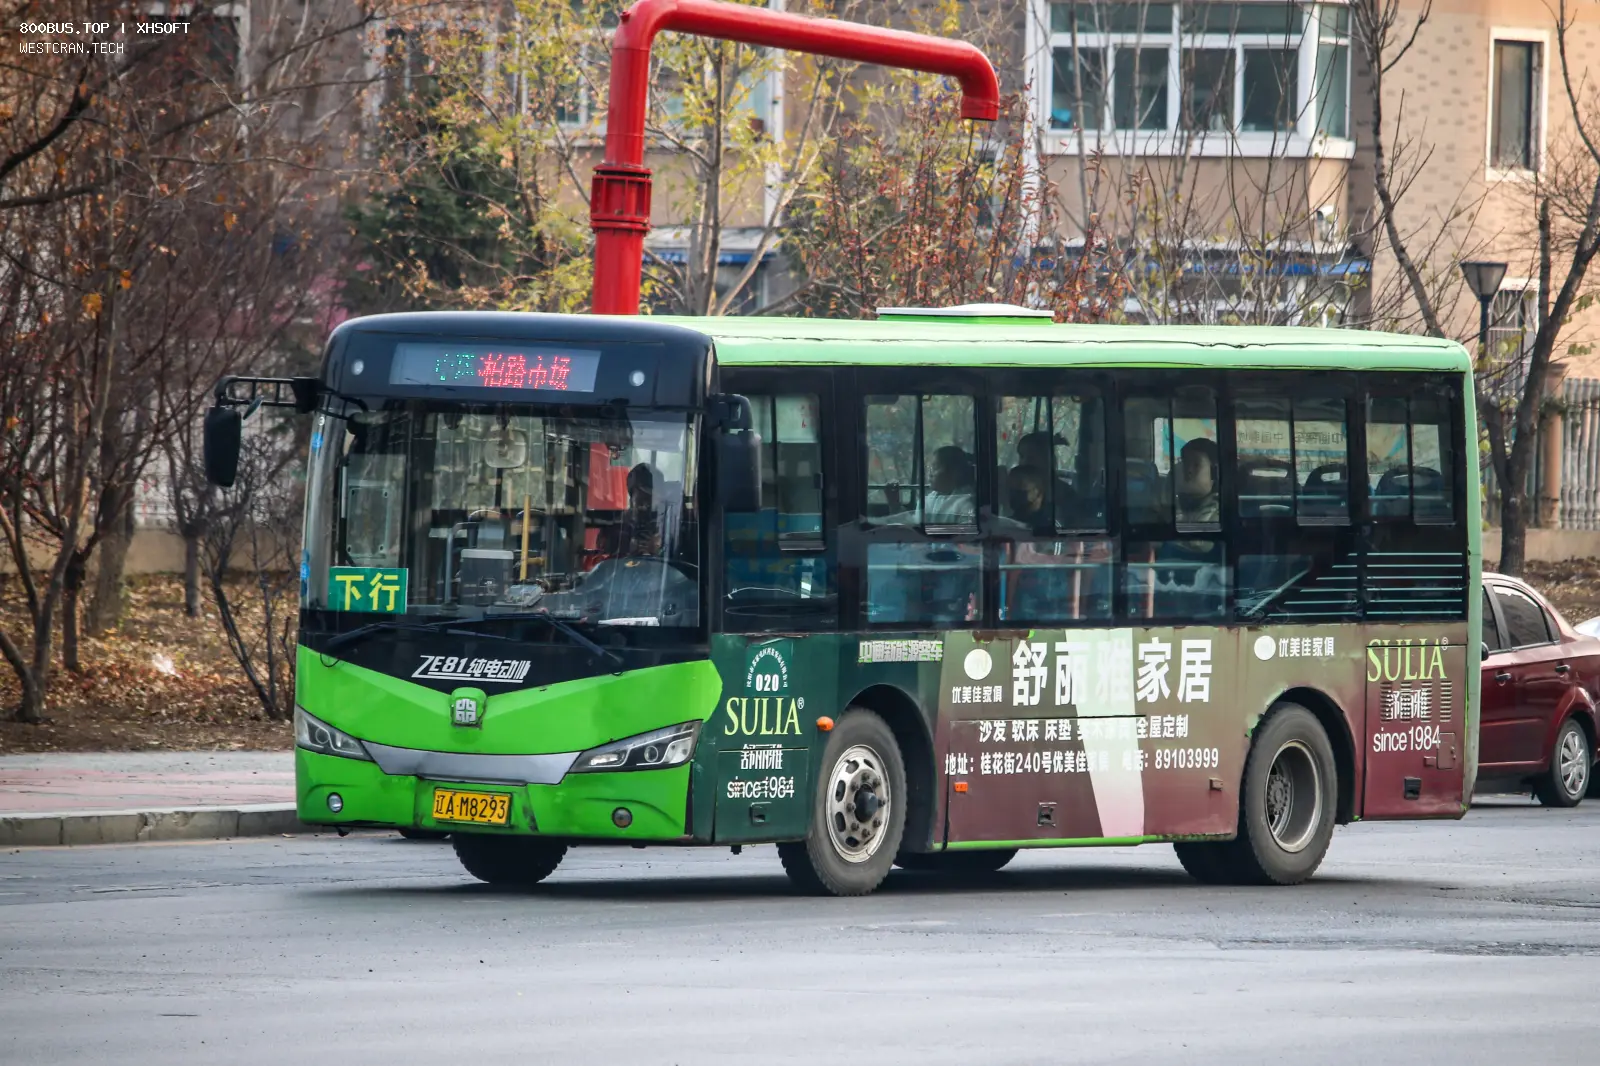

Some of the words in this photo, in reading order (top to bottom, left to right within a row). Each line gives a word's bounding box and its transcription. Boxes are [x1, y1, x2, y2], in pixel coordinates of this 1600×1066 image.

[335, 572, 400, 611] 下行
[756, 673, 779, 691] 020
[1012, 637, 1212, 706] 舒丽雅家居
[979, 720, 1006, 743] 沙发
[1012, 720, 1039, 742] 软床
[1044, 719, 1071, 741] 床垫
[1136, 714, 1188, 739] 全屋定制
[741, 744, 783, 770] 舒丽雅
